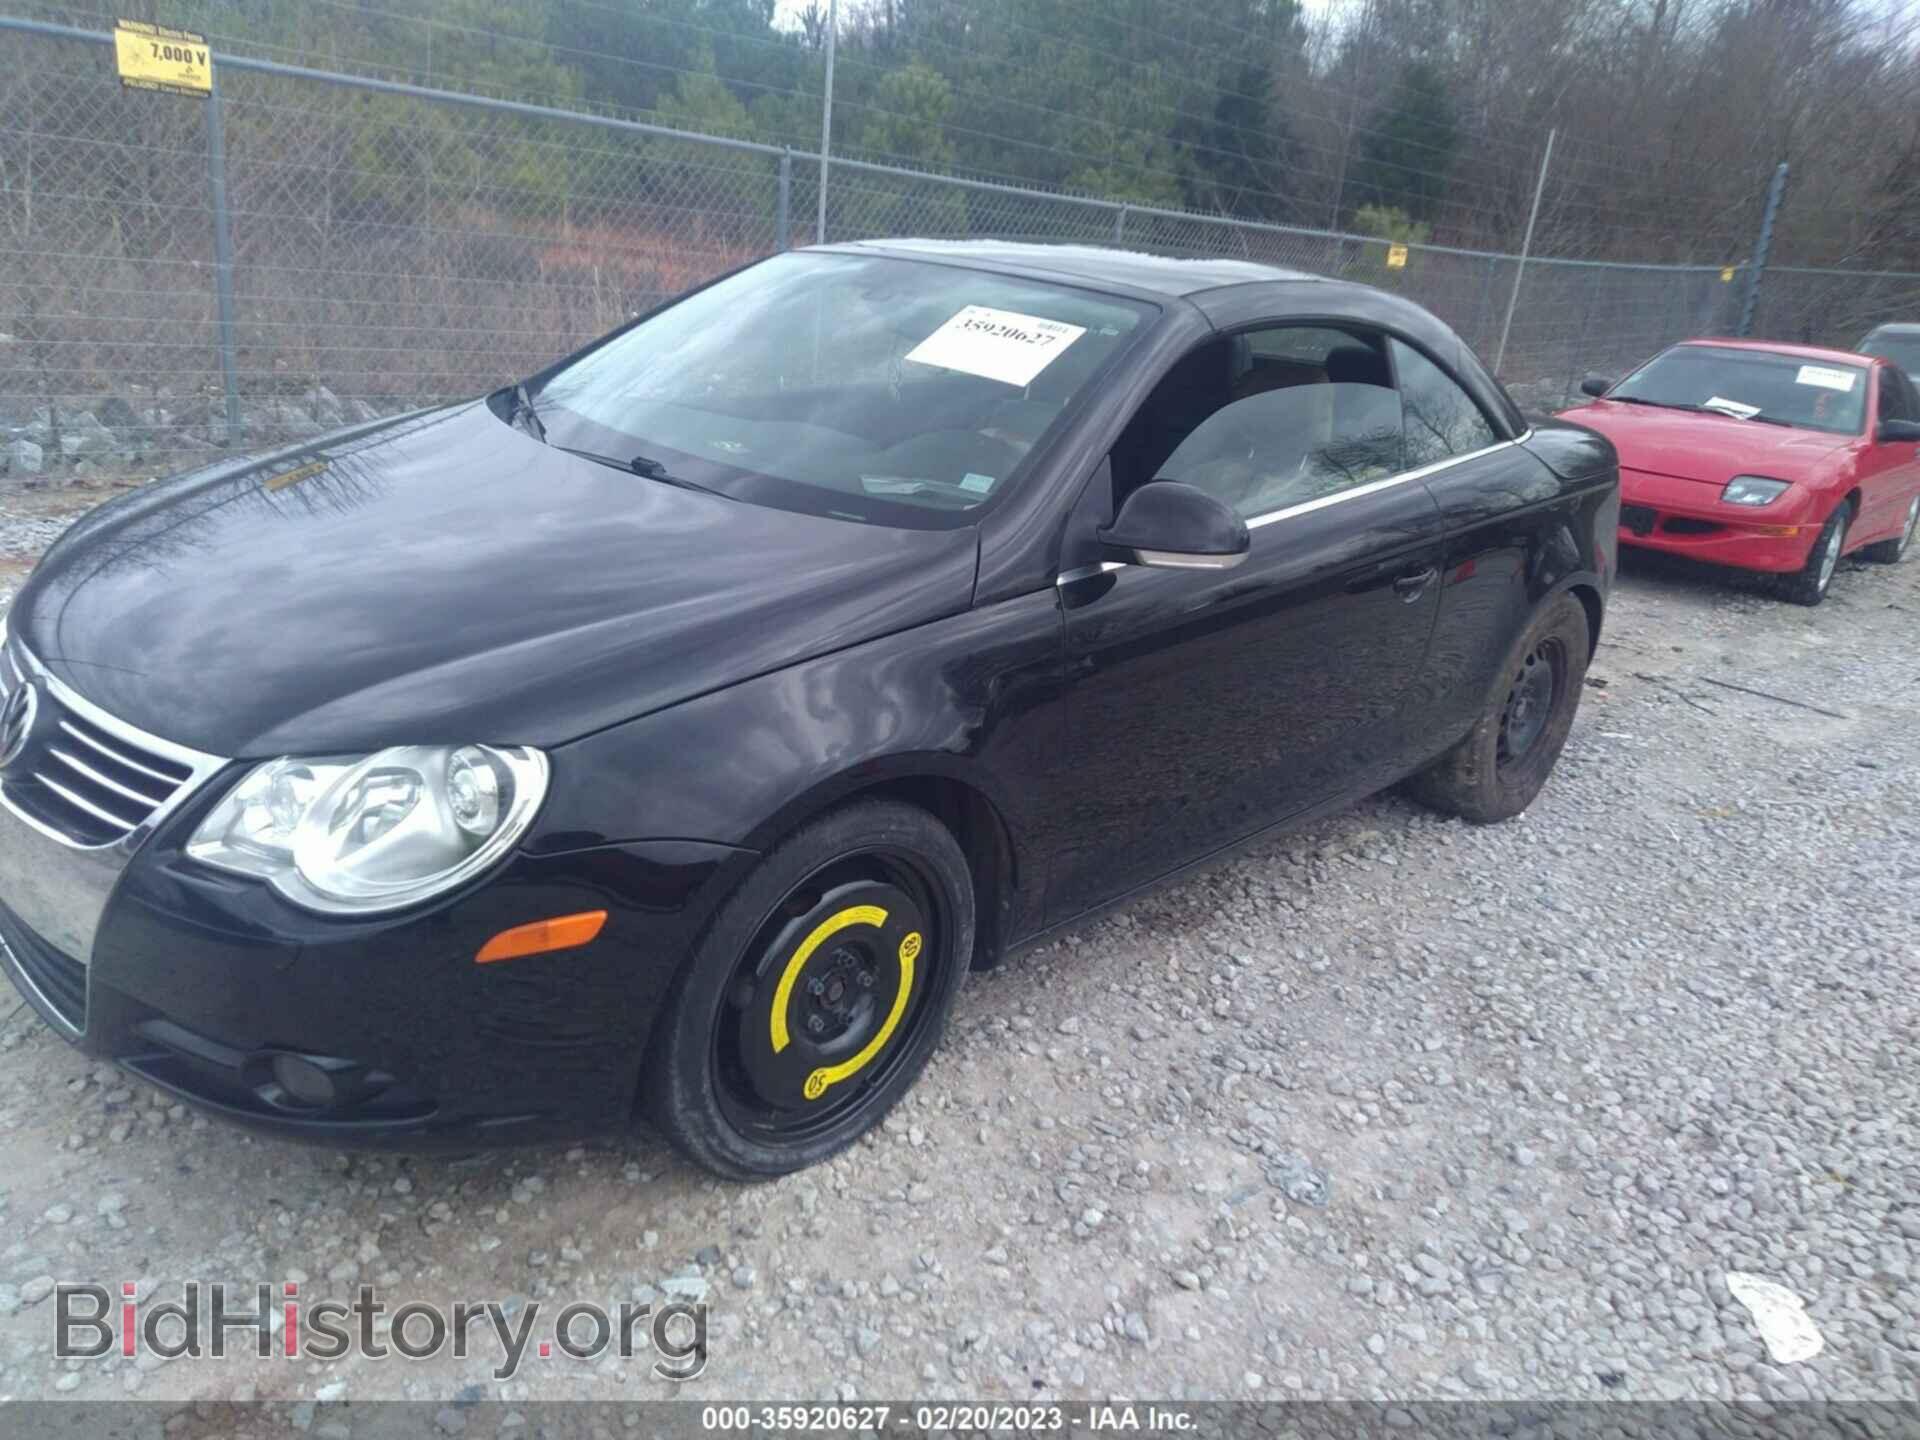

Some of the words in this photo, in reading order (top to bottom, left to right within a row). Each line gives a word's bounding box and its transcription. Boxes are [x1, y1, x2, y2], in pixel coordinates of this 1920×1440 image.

[150, 42, 193, 64] 7,000
[196, 51, 206, 67] V
[904, 935, 918, 958] 80
[808, 1074, 826, 1093] 50
